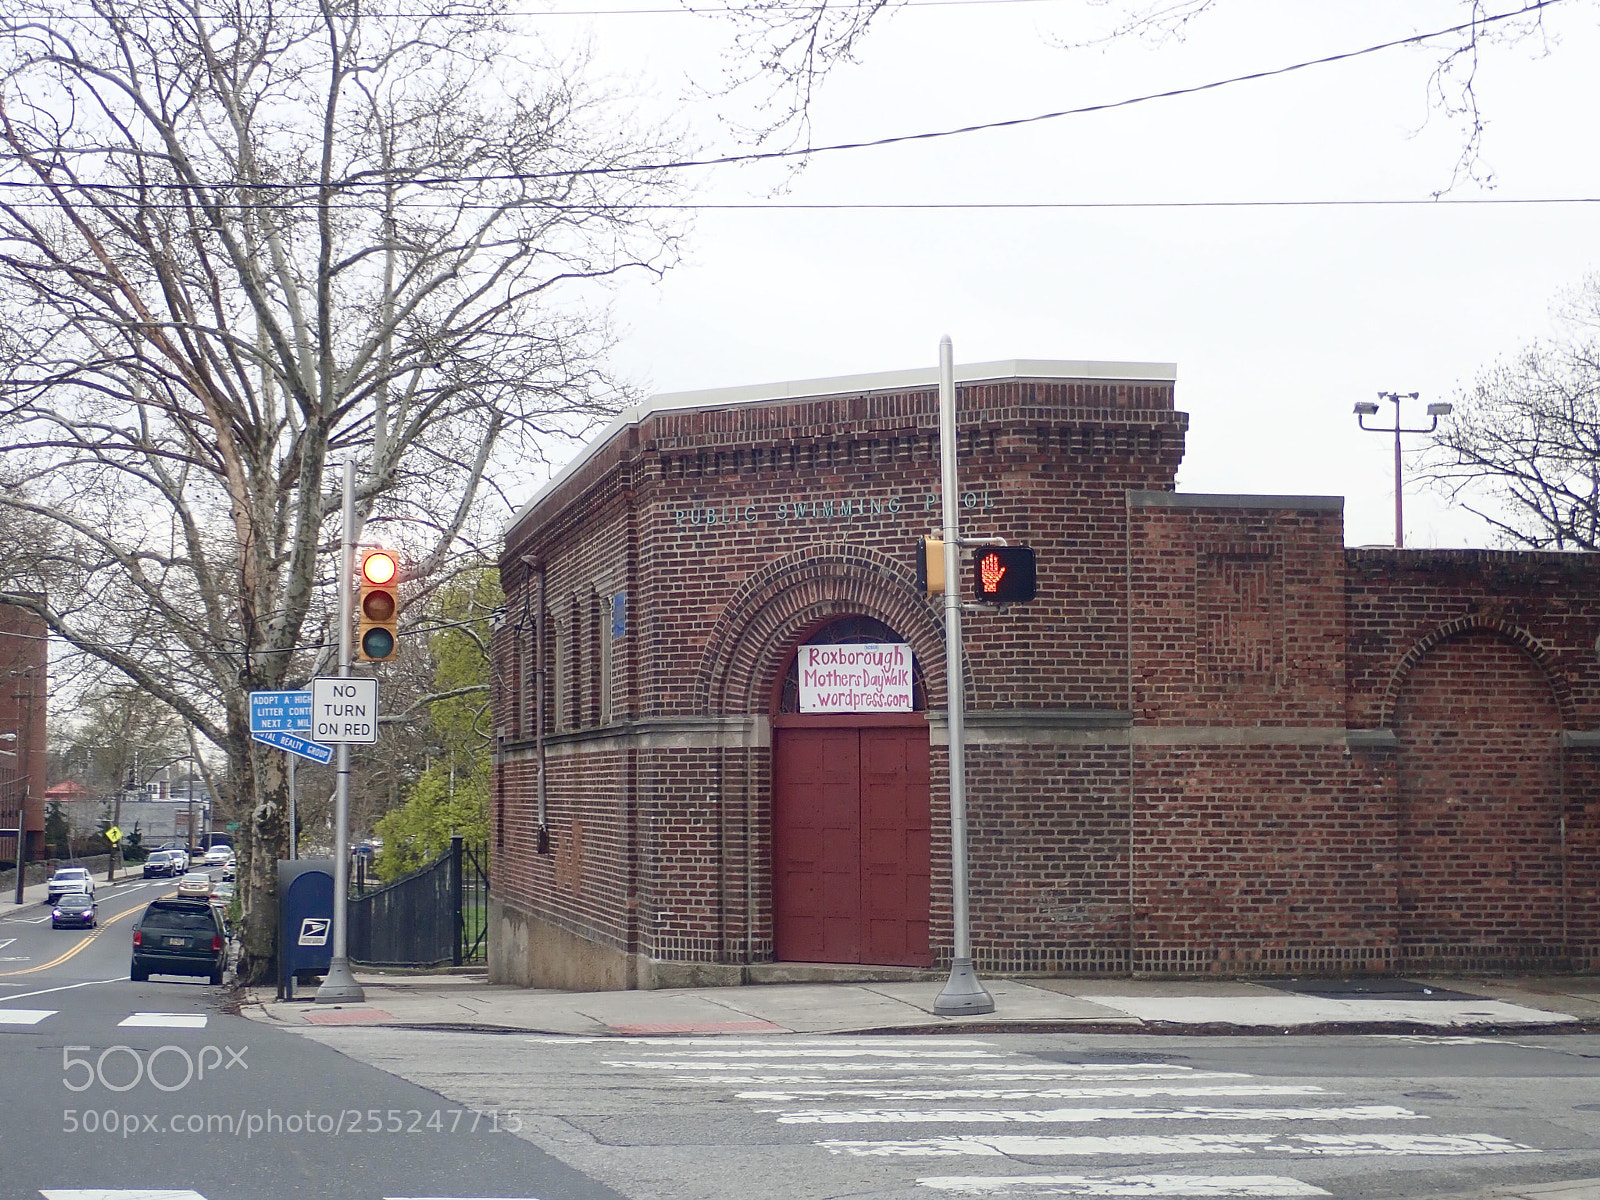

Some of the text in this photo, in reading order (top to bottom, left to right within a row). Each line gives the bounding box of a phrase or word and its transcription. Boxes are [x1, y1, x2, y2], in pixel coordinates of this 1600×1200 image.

[675, 491, 995, 525] PUBLIC SWIMMING POL
[809, 646, 904, 673] Roxborough
[333, 685, 356, 698] NO
[253, 696, 278, 705] ADOPT
[257, 707, 284, 717] LITTER
[324, 704, 366, 717] TURN
[261, 719, 281, 728] NEXT
[286, 718, 292, 728] 2
[318, 723, 370, 736] ON RED
[255, 731, 329, 759] OYAL REALTY GROUP
